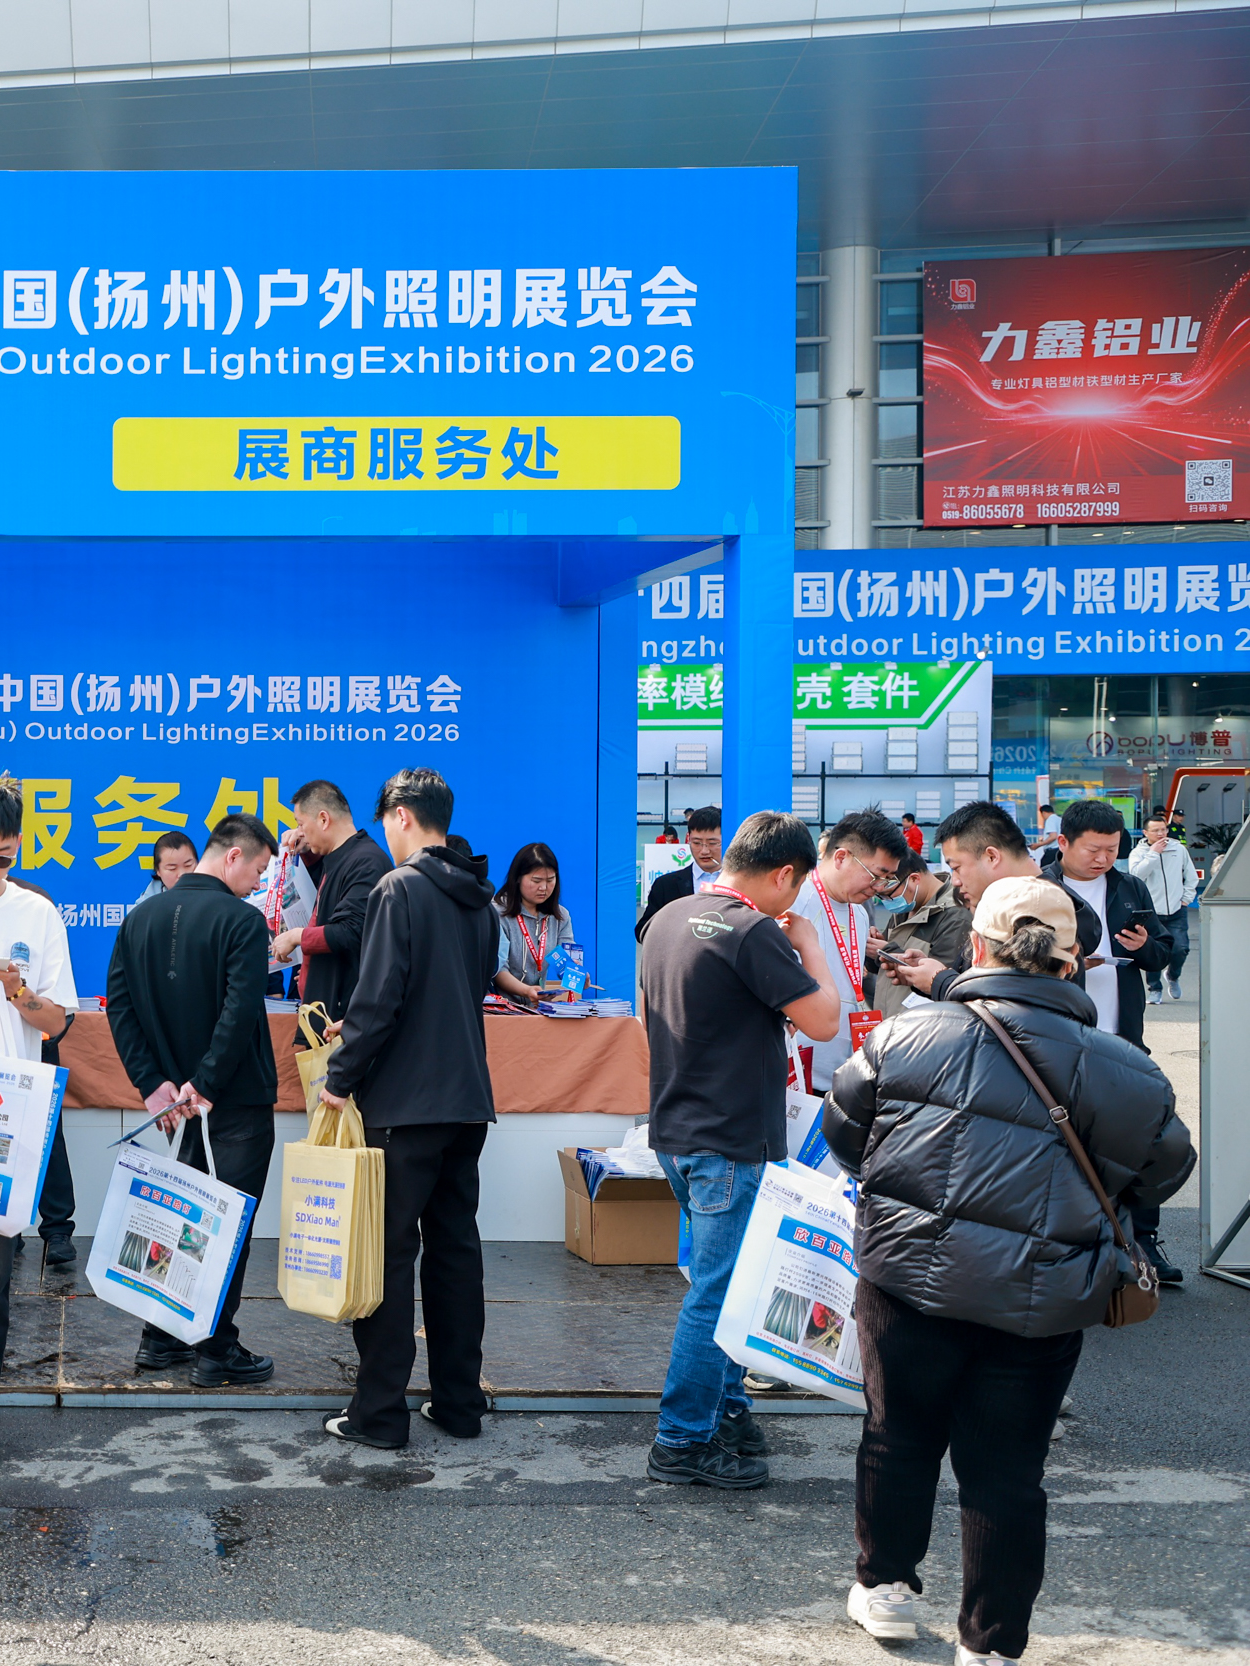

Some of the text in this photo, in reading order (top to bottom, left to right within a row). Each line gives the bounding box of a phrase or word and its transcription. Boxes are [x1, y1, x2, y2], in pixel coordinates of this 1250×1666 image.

[979, 315, 1202, 363] 力鑫铝业
[183, 345, 575, 380] LightingExhibition
[588, 344, 694, 374] 2026
[990, 372, 1184, 391] 专业灯具铝型材铁型材生产厂家
[233, 425, 560, 481] 展商服务处
[942, 482, 1120, 499] 江苏力鑫照明科技有限公司
[1036, 501, 1120, 518] 16605287999
[1188, 503, 1228, 513] 扫码咨询
[637, 574, 724, 620] 四届
[642, 635, 724, 663] ngzh
[793, 632, 903, 657] utdoor
[912, 632, 1045, 663] Lighting
[1055, 628, 1223, 654] Exhibition
[796, 675, 832, 710] 壳
[842, 672, 920, 710] 套件
[24, 721, 135, 741] Outdoor
[142, 723, 386, 745] LightingExhibition
[394, 723, 460, 742] 2026
[1189, 729, 1232, 748] 博普
[172, 904, 182, 936] DESCENTE
[139, 1185, 193, 1216] 欣百亚路灯
[304, 1194, 336, 1210] 小满科技
[295, 1212, 324, 1226] SDXiao
